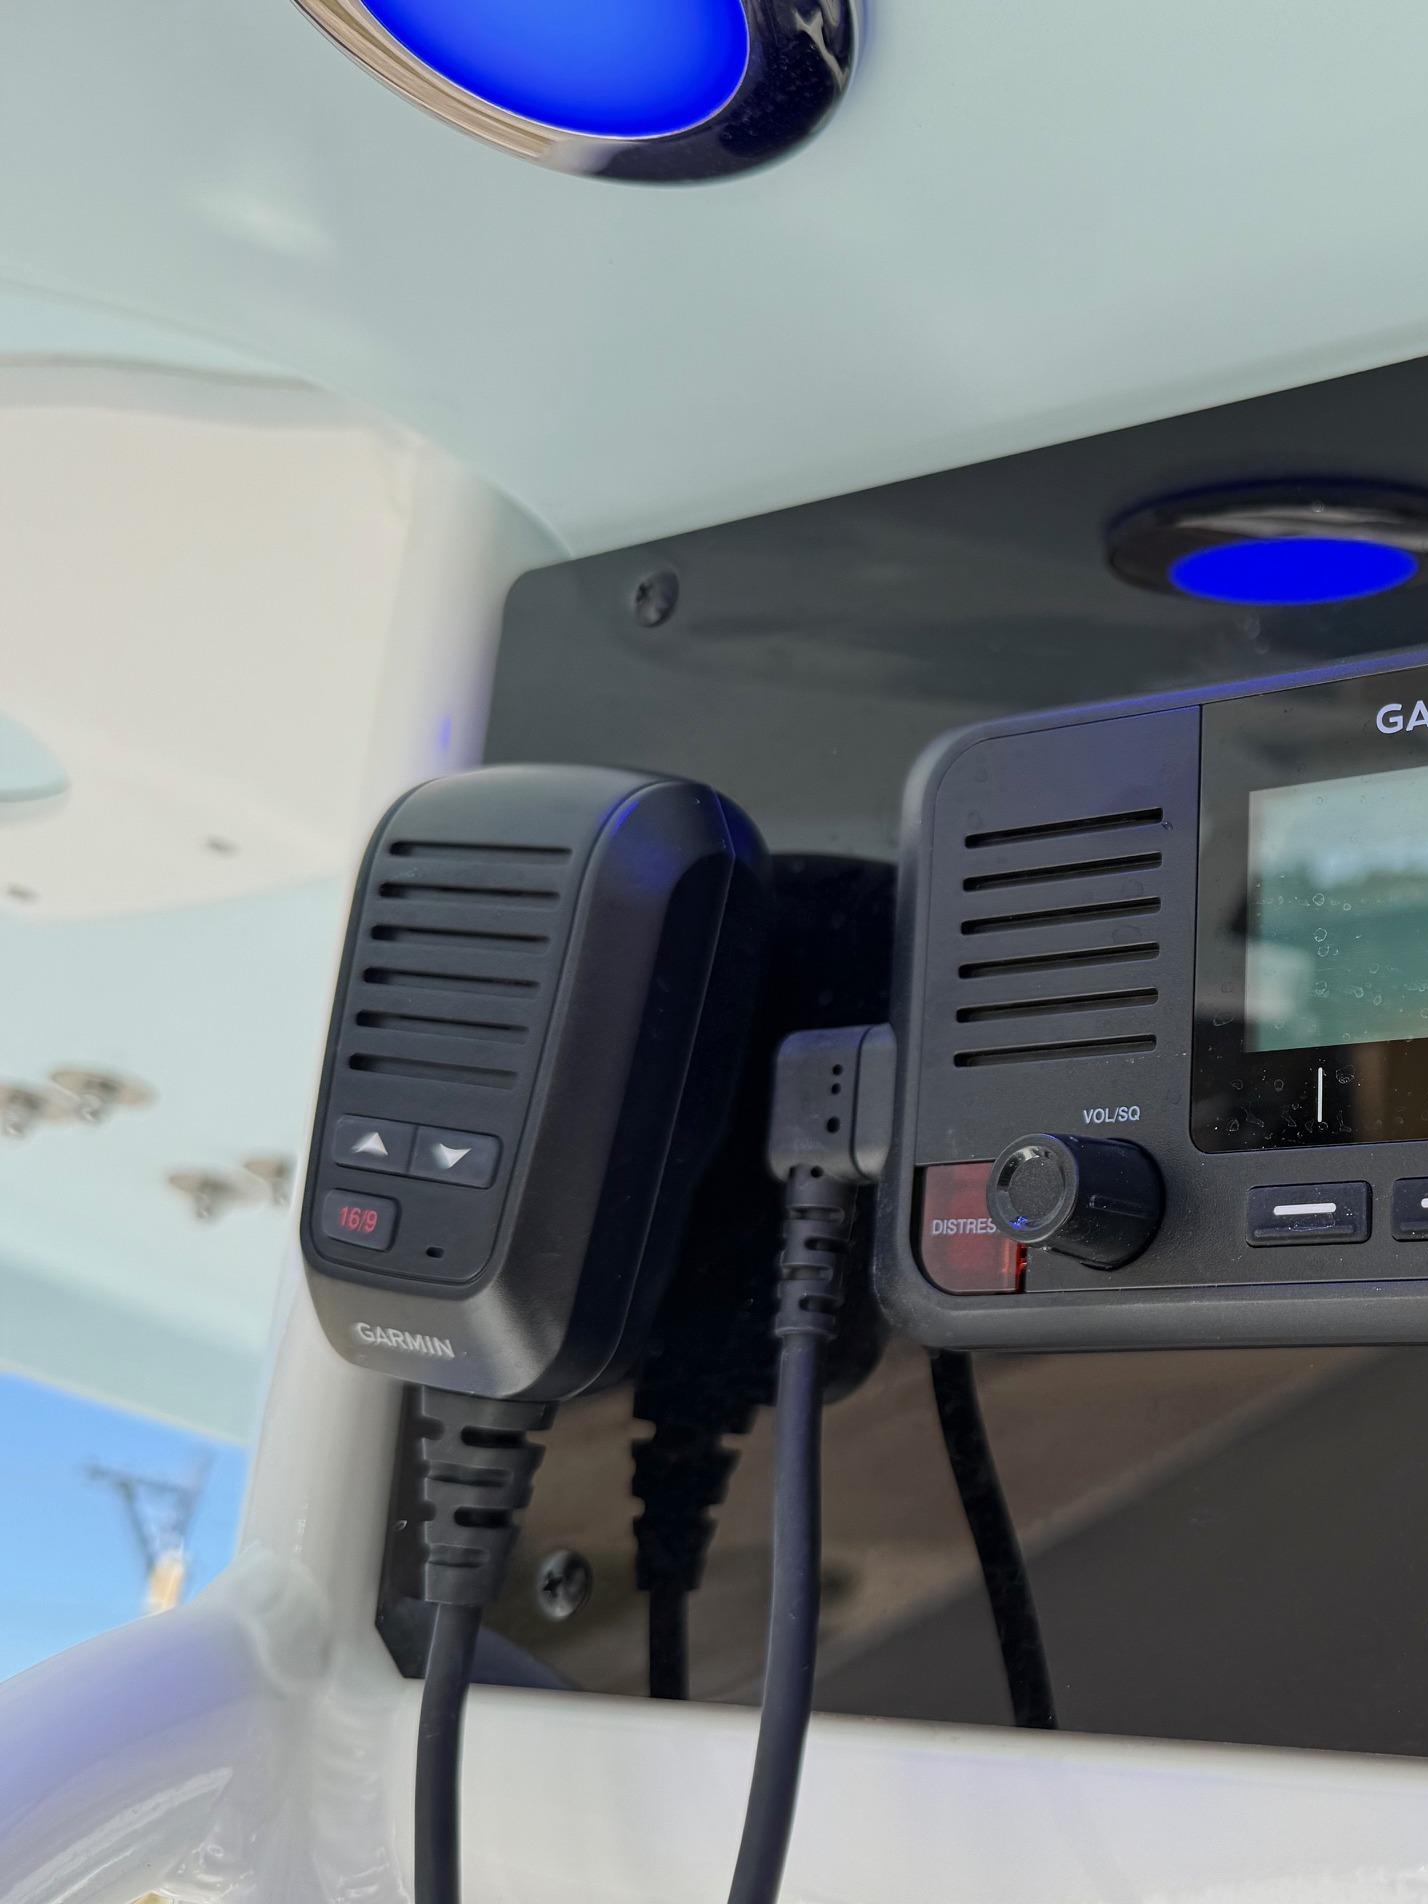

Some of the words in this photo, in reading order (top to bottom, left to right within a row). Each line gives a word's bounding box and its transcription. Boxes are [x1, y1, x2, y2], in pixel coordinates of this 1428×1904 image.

[1083, 1106, 1141, 1125] VOL/SQ
[338, 1206, 378, 1233] 16/9
[932, 1218, 1000, 1234] DISTRES
[354, 1322, 455, 1358] GARMIN
